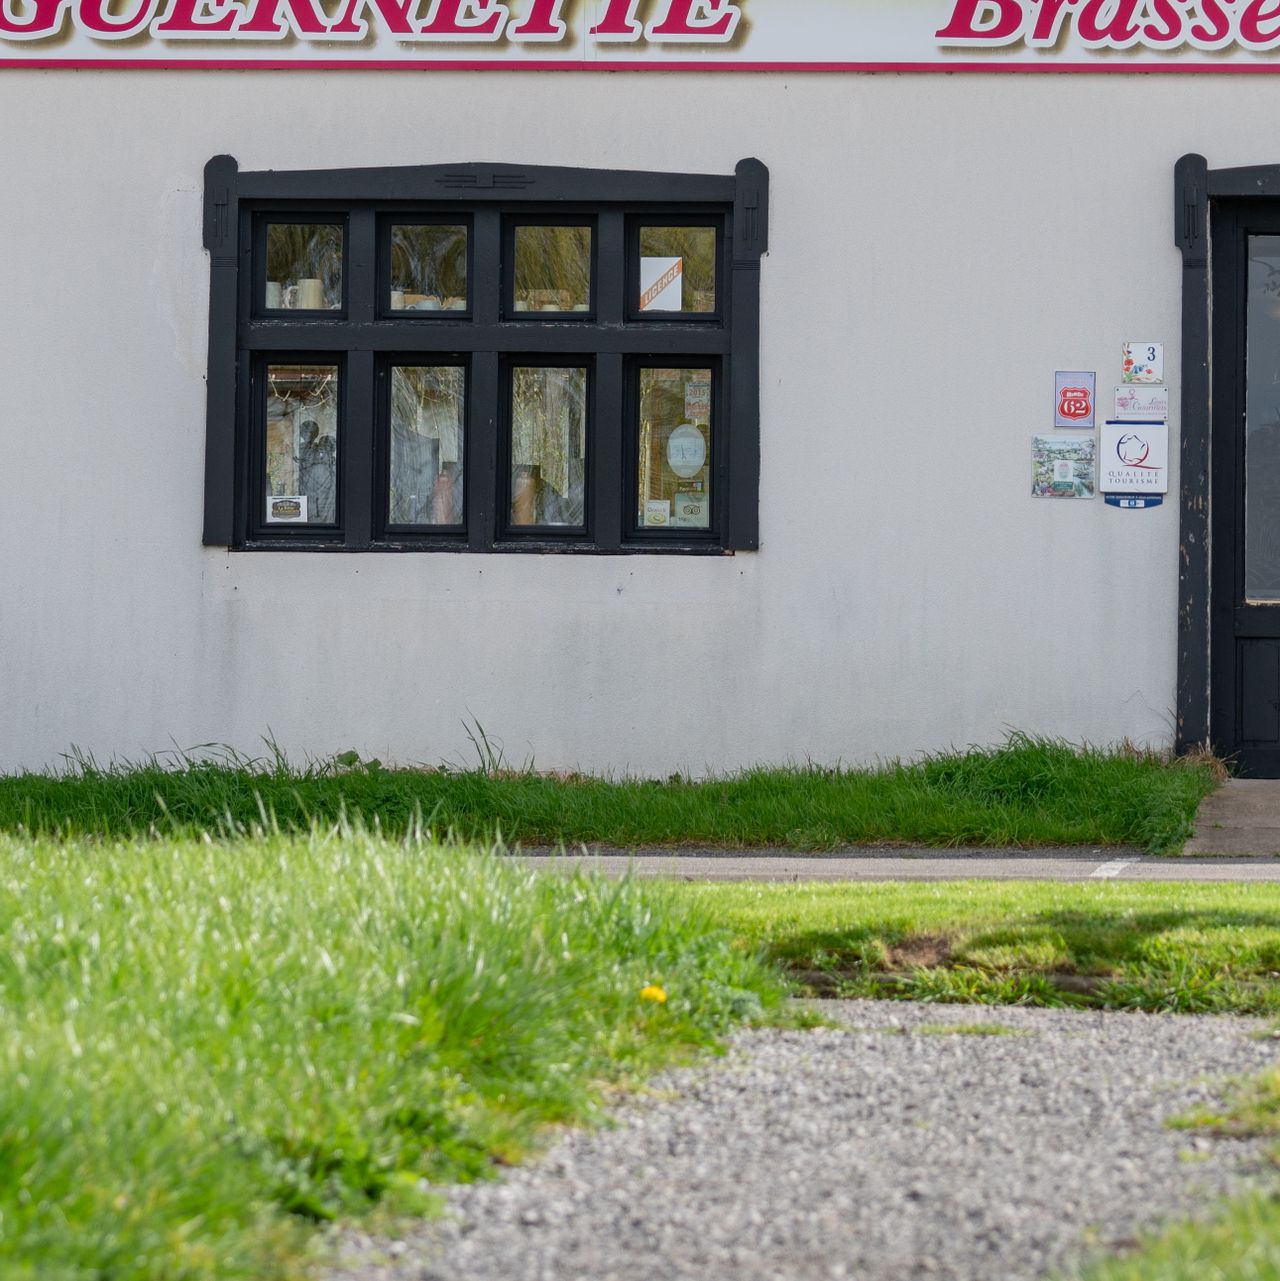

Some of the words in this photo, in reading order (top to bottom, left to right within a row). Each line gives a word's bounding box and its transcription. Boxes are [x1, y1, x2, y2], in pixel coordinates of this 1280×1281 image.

[644, 264, 679, 304] LICENCE
[1147, 346, 1156, 362] 3
[1063, 400, 1087, 414] 62
